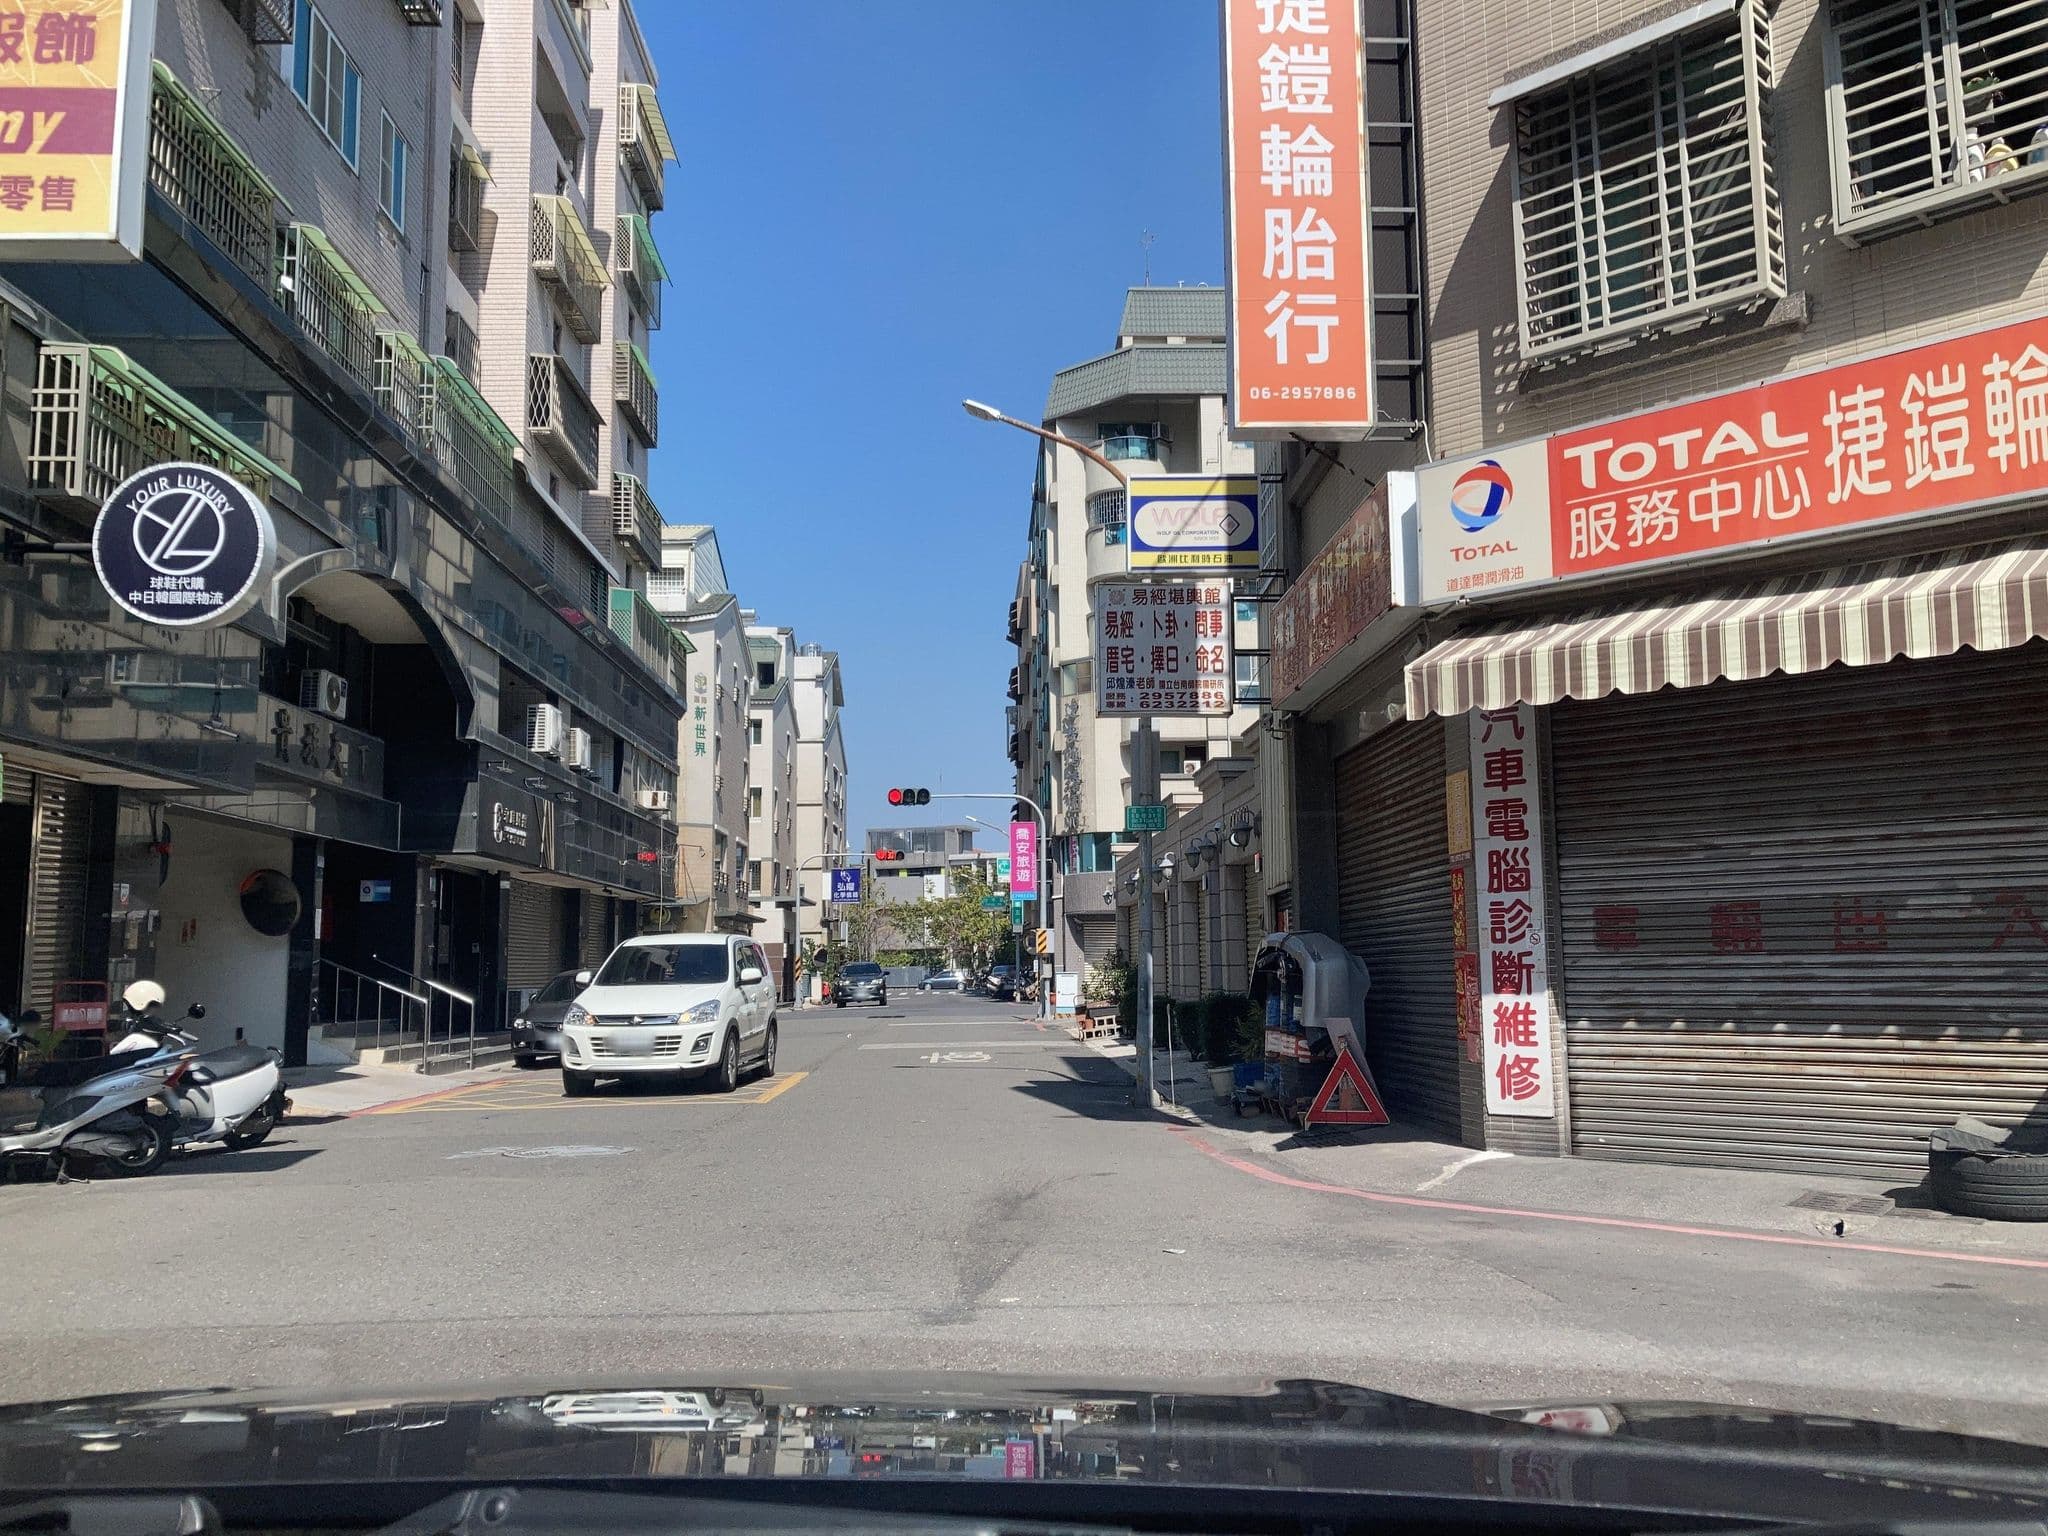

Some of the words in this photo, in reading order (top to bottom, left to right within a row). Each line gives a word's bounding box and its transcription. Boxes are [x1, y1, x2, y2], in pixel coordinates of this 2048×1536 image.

[0, 175, 76, 211] 零售
[1250, 386, 1357, 401] 06-2957886
[1563, 410, 1809, 489] TOTAL
[126, 477, 170, 514] YOUR
[177, 473, 235, 516] LUXURY
[1569, 464, 1811, 560] 服務中心
[1449, 540, 1518, 563] TOTAL
[149, 576, 205, 591] 球鞋代購
[1446, 565, 1524, 592] 道達爾潤滑油
[128, 591, 224, 606] 中日韓國際物流
[1139, 691, 1225, 700] 2957886
[1139, 700, 1225, 709] 6232212
[693, 705, 707, 757] 新世界
[1479, 705, 1541, 1101] 汽車電腦診斷維修
